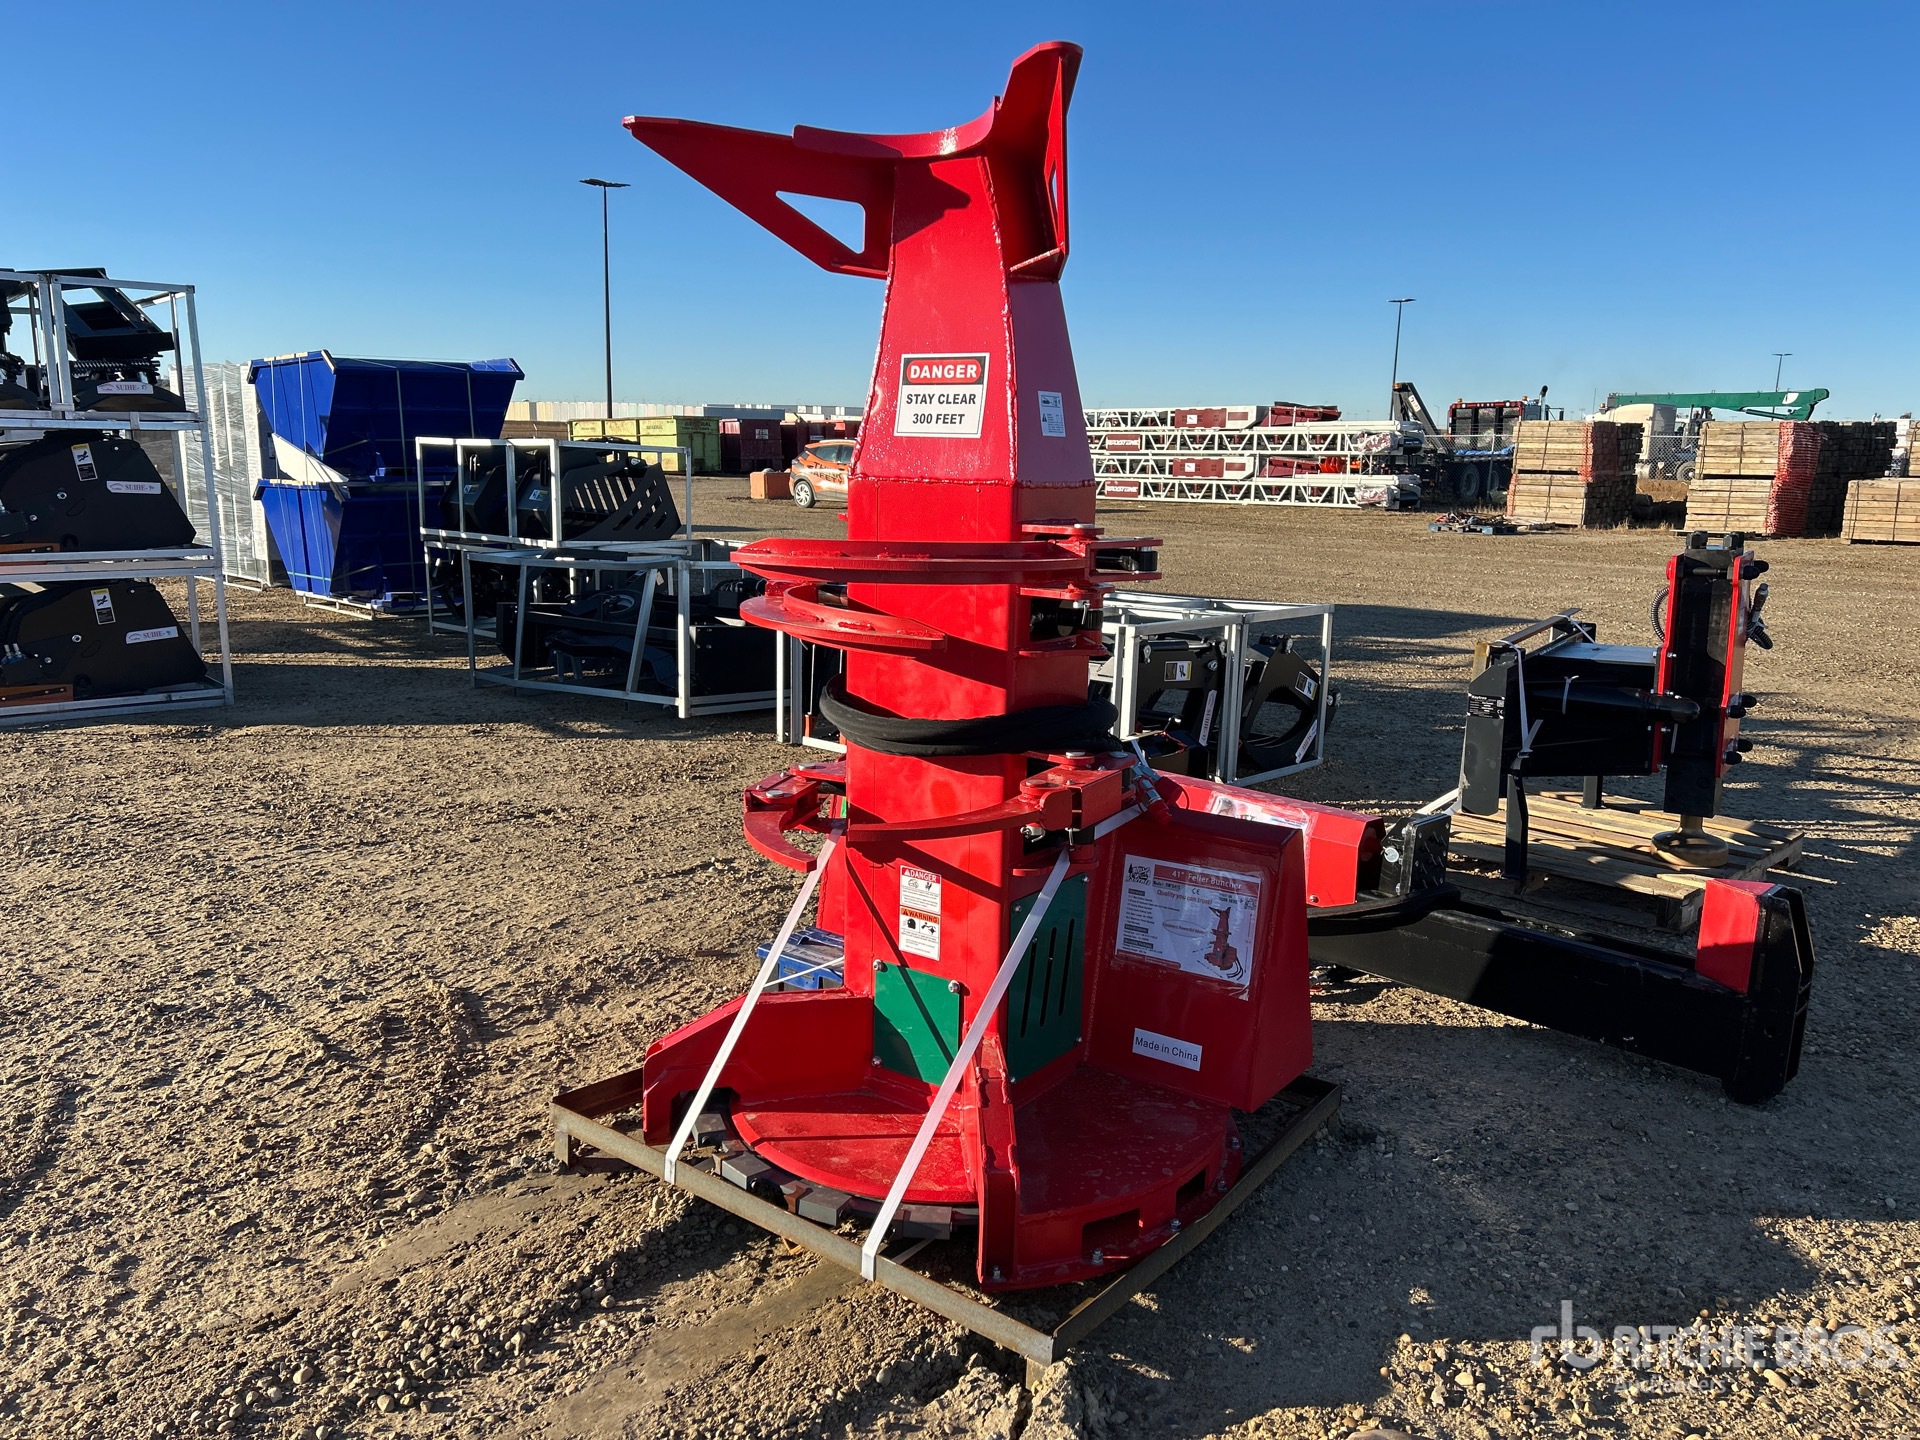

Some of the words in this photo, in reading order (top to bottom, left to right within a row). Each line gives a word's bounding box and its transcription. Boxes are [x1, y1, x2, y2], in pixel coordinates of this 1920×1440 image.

[910, 364, 977, 379] DANGER
[906, 393, 935, 405] STAY
[937, 393, 977, 405] CLEAR
[912, 413, 933, 425] 300
[935, 413, 965, 425] FEET
[909, 869, 938, 883] DANGER
[1187, 873, 1210, 884] Feller
[1211, 877, 1242, 890] Buncher
[1156, 889, 1176, 899] Quality
[909, 911, 938, 924] WARNING
[1135, 1036, 1160, 1051] Made
[1161, 1043, 1170, 1053] in
[1171, 1047, 1198, 1062] China
